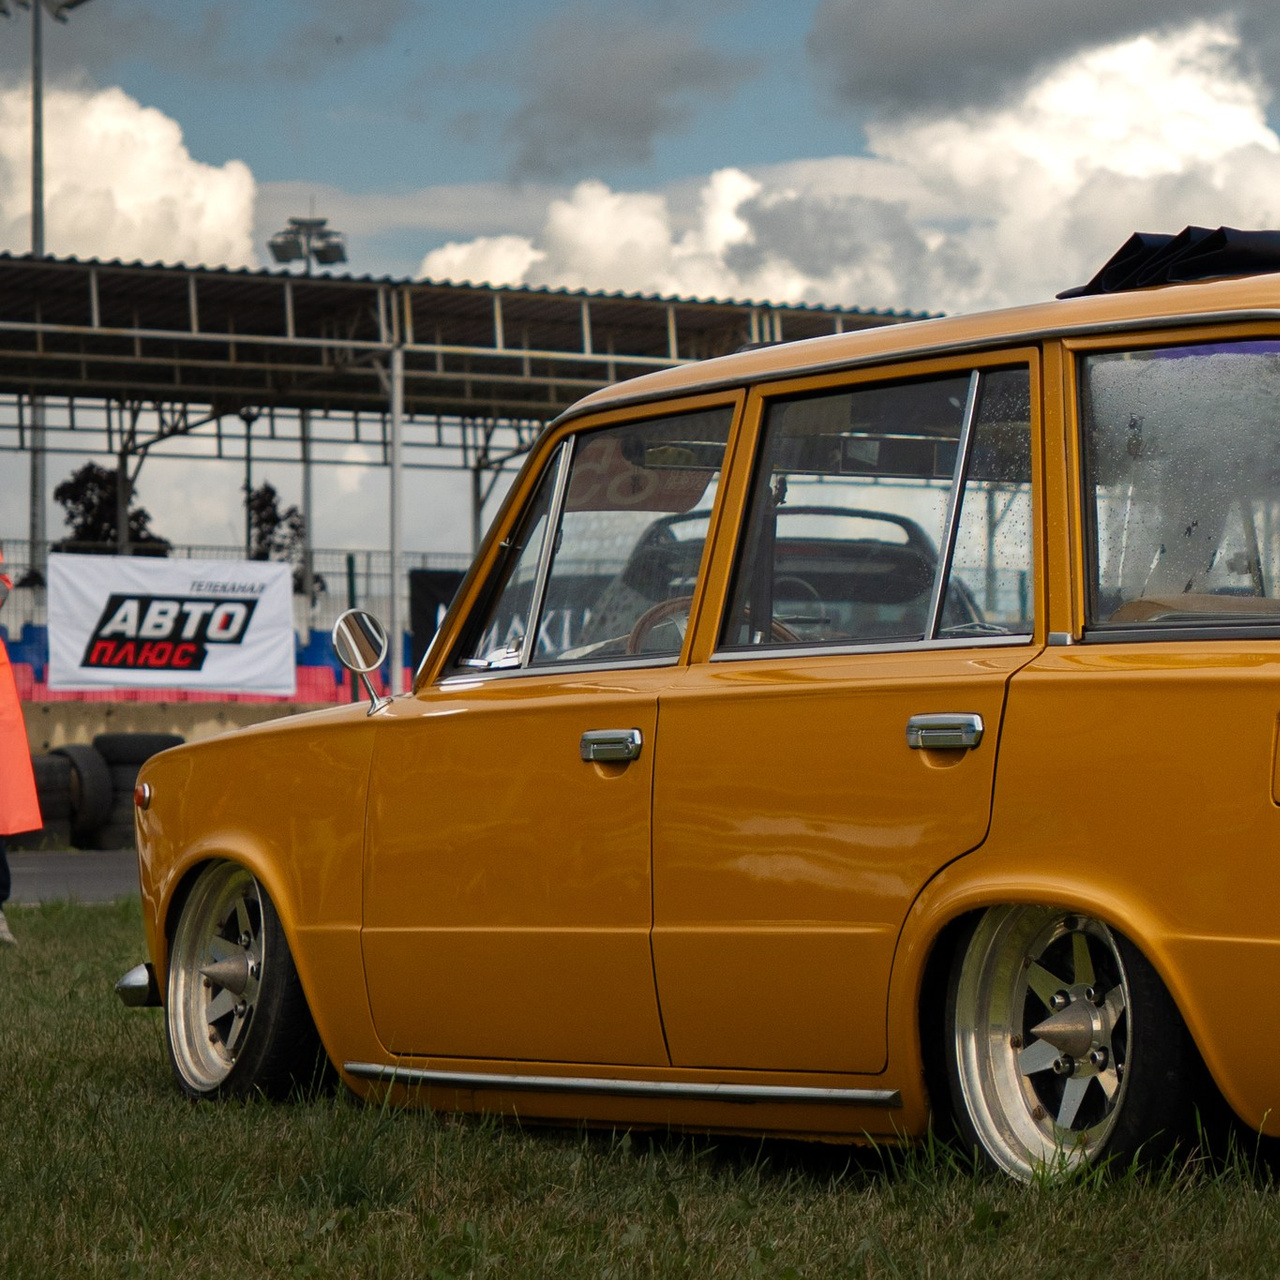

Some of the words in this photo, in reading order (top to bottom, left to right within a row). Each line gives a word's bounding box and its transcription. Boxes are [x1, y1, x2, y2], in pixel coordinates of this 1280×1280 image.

[190, 580, 267, 594] ТЕЛЕКАНАЛ
[100, 599, 248, 642] АВТО
[89, 640, 198, 668] ПЛЮС
